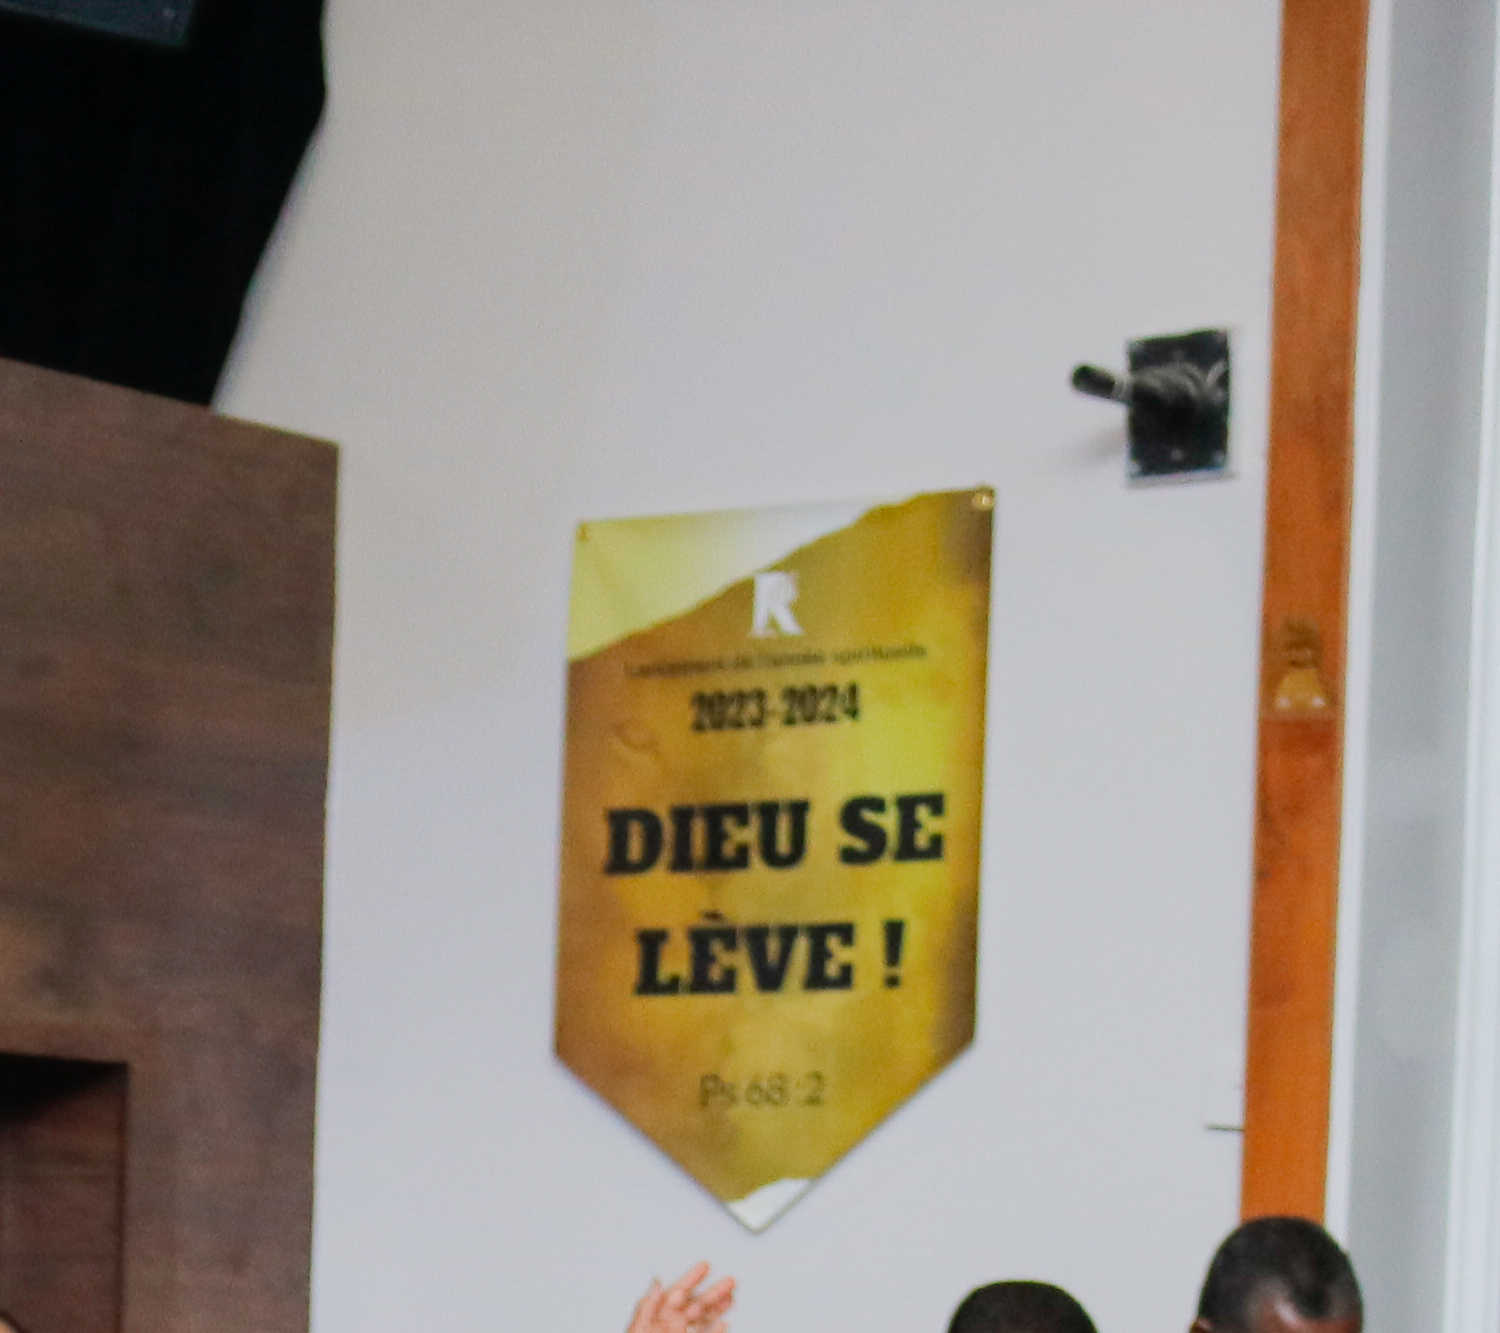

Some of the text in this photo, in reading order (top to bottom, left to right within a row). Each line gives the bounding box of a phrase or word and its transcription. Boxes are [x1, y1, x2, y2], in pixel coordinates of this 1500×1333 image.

[752, 571, 802, 637] R
[693, 683, 860, 732] 2023-2024
[604, 793, 945, 875] DIEU SE
[634, 910, 855, 996] LÈVE
